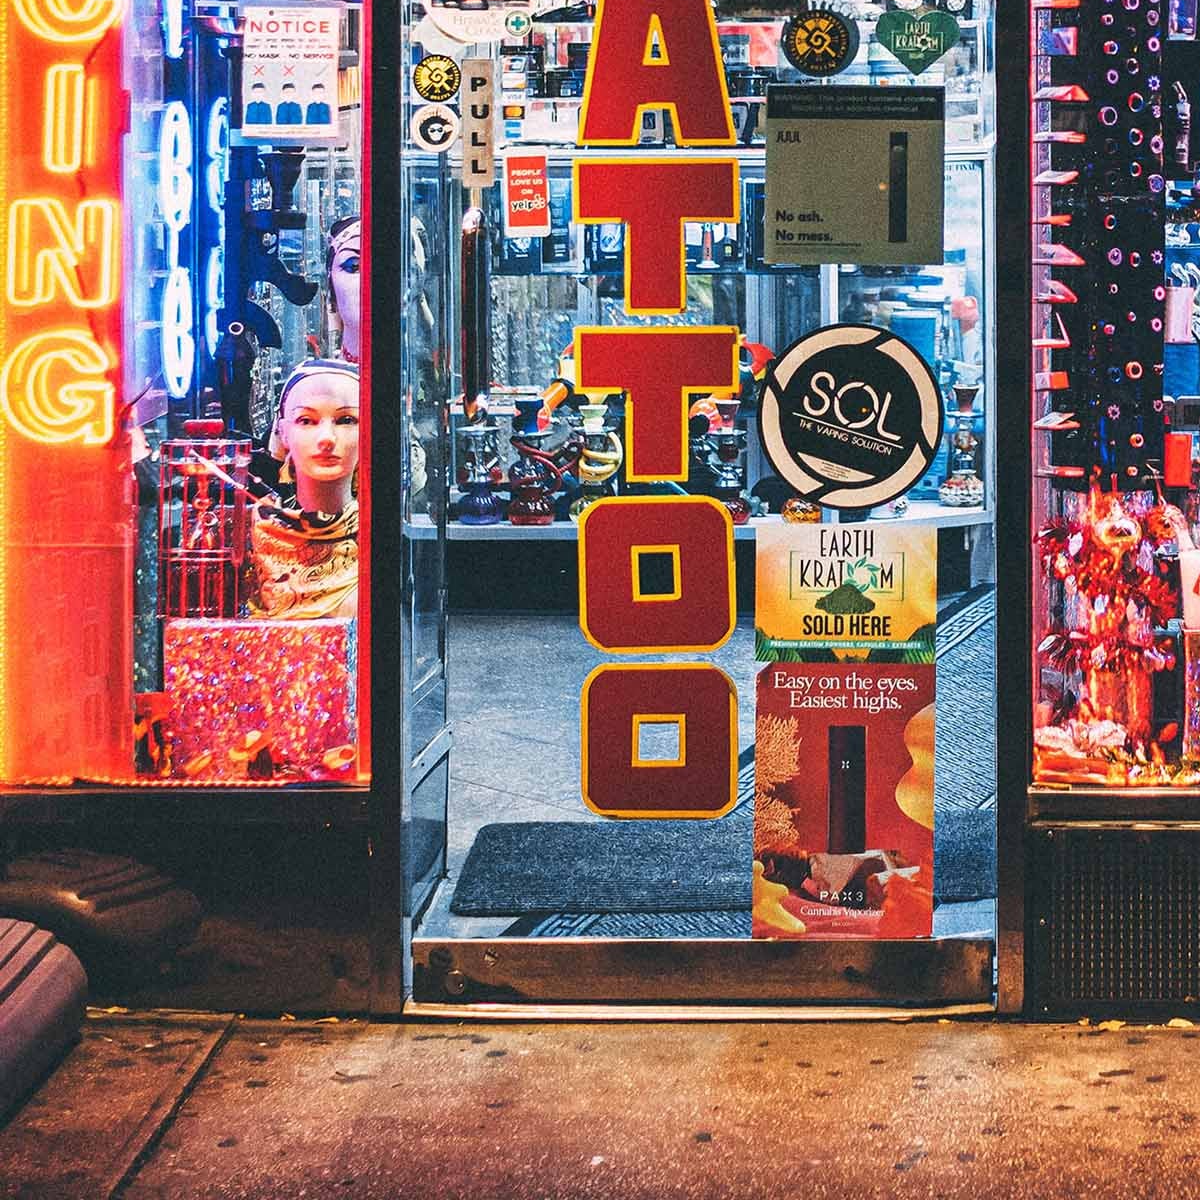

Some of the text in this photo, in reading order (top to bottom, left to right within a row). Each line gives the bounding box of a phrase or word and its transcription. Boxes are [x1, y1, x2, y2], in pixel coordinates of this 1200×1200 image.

[250, 21, 330, 33] NOTICE
[471, 77, 489, 174] PULL
[511, 200, 535, 212] yelp
[776, 211, 824, 222] No ash.
[776, 230, 833, 241] No mess.
[803, 372, 901, 441] SOL
[800, 420, 893, 456] THE VAPING SOLUTION
[820, 529, 875, 557] EARTH
[803, 615, 892, 636] SOLD HERE
[774, 672, 918, 694] Easy on the eyes.
[790, 690, 902, 713] Easiest highs.
[820, 891, 864, 902] PAX 3
[800, 907, 886, 919] Cannabis Vaporizer
